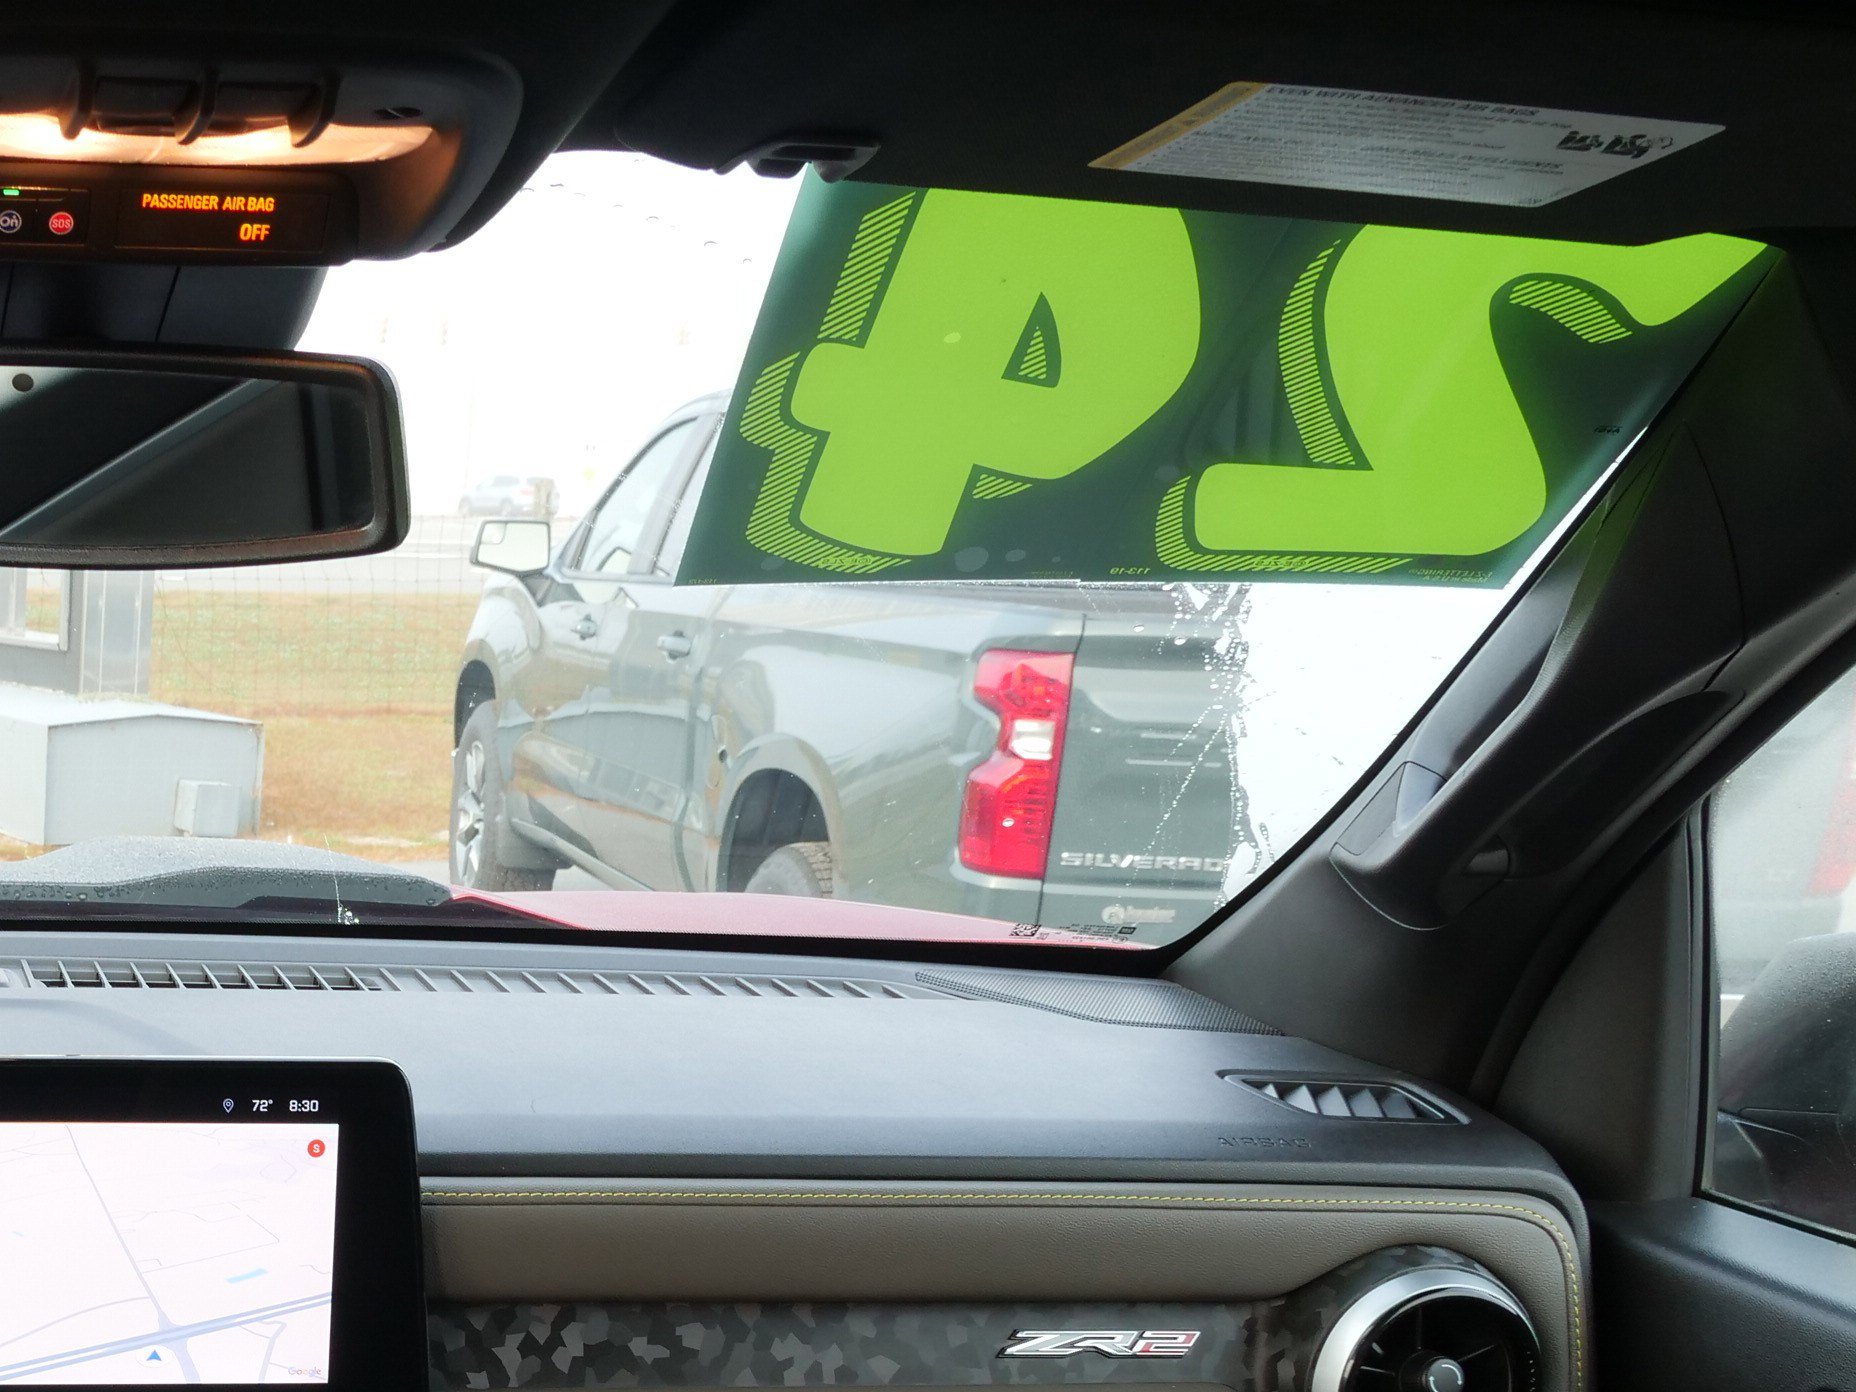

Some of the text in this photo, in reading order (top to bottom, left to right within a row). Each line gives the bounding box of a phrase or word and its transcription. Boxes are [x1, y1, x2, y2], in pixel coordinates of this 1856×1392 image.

[142, 193, 275, 212] PASSENGER AIR BAG
[51, 219, 72, 230] SOS
[239, 223, 271, 241] OFF
[1060, 852, 1224, 872] SILVERAD
[289, 1099, 319, 1112] 8:30
[1218, 1137, 1311, 1148] AIRBAG
[999, 1329, 1201, 1357] ZR2
